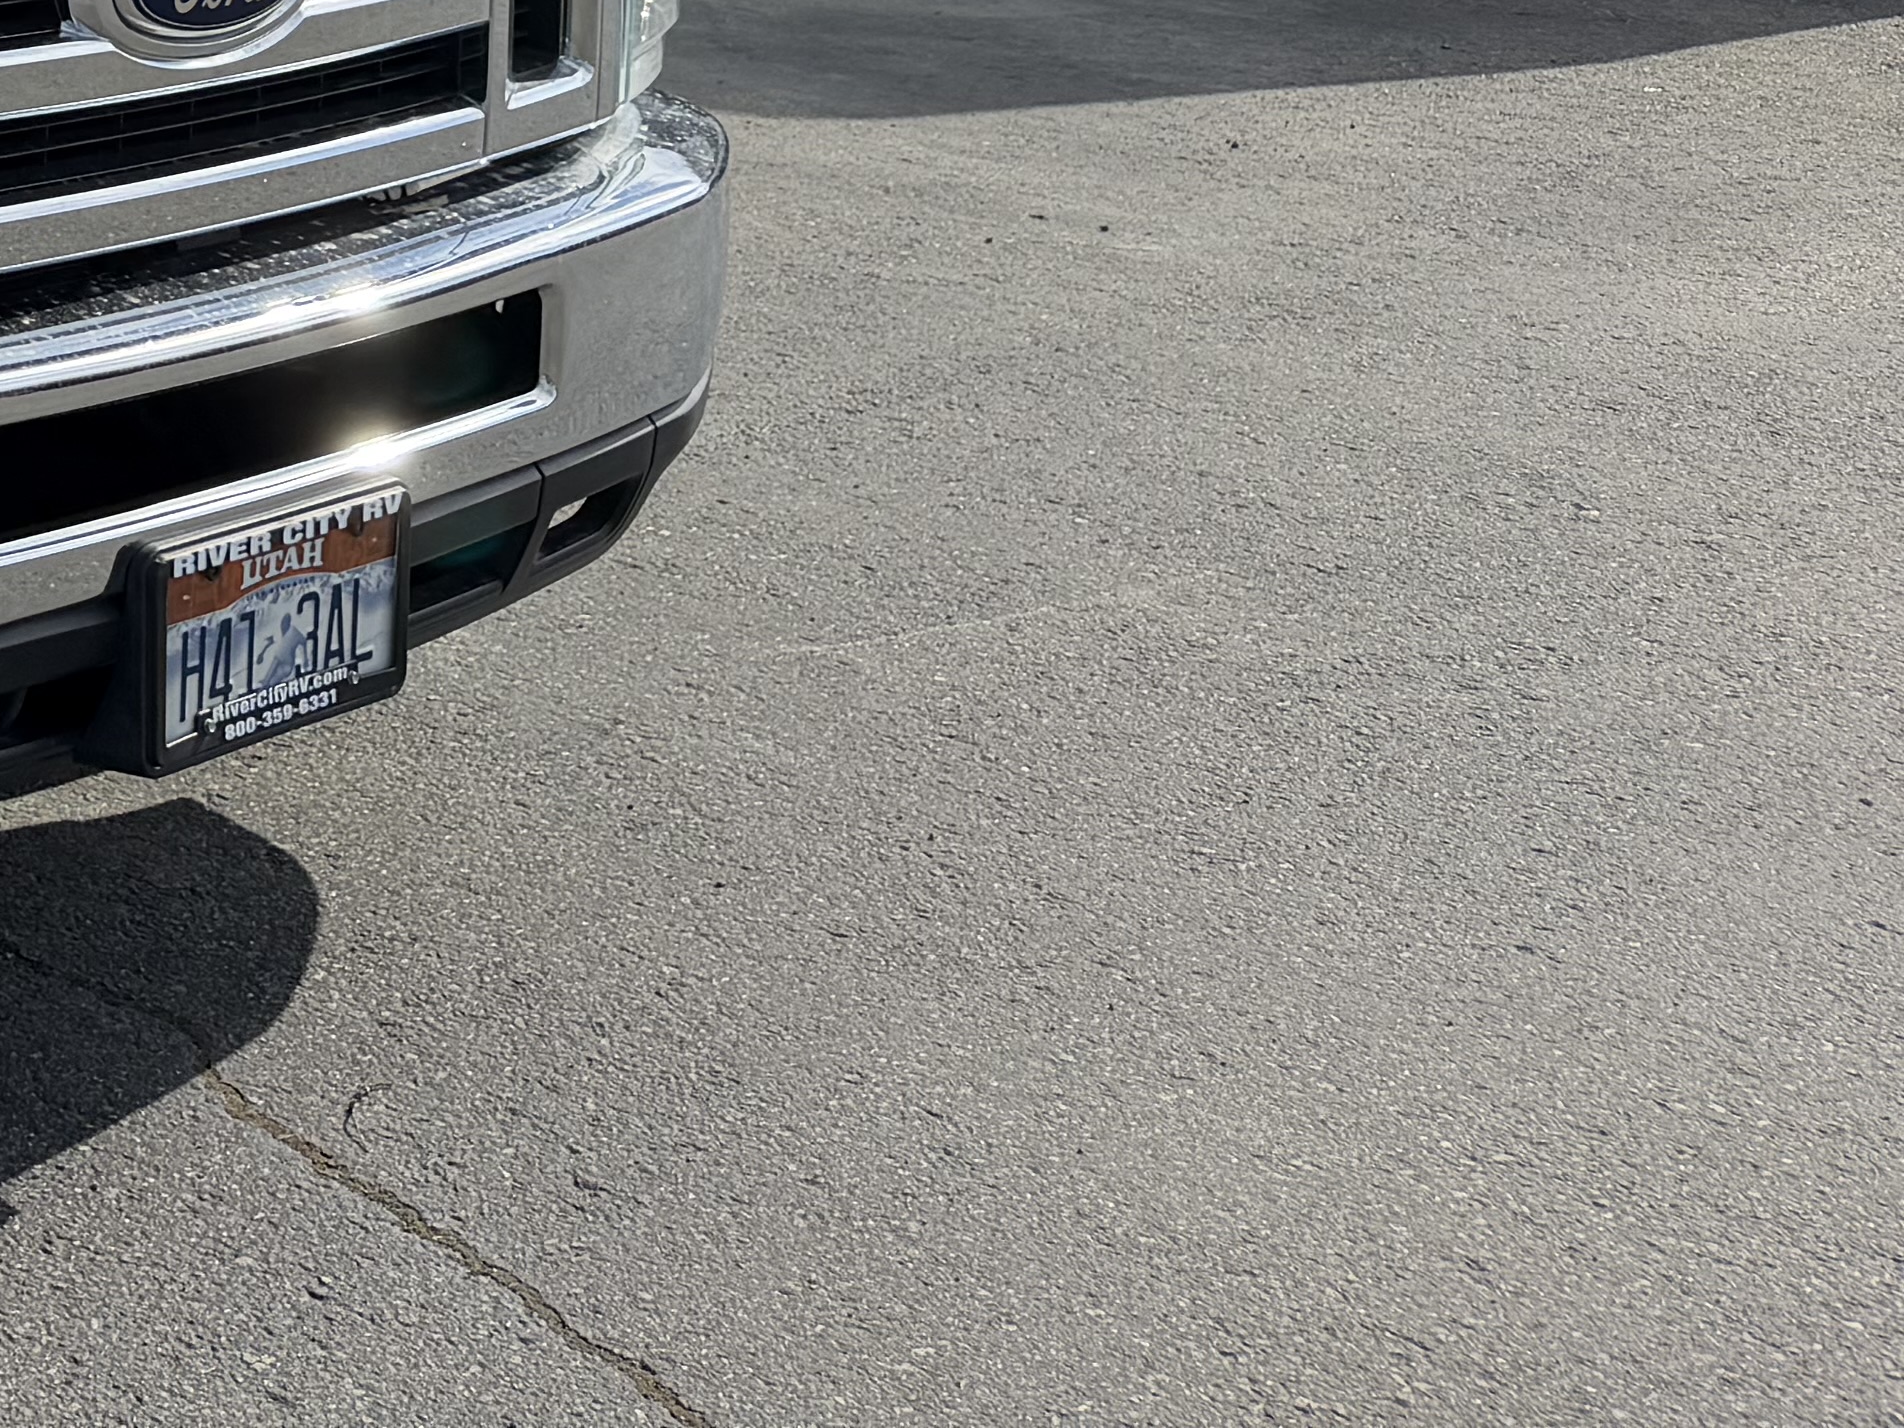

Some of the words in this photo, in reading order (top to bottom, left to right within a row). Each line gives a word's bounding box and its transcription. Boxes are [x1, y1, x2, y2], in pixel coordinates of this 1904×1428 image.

[172, 532, 272, 578] RIVER
[282, 508, 352, 545] CITY
[362, 493, 404, 522] RV
[240, 538, 325, 590] UTAH
[212, 667, 349, 724] RiverCityRV.com
